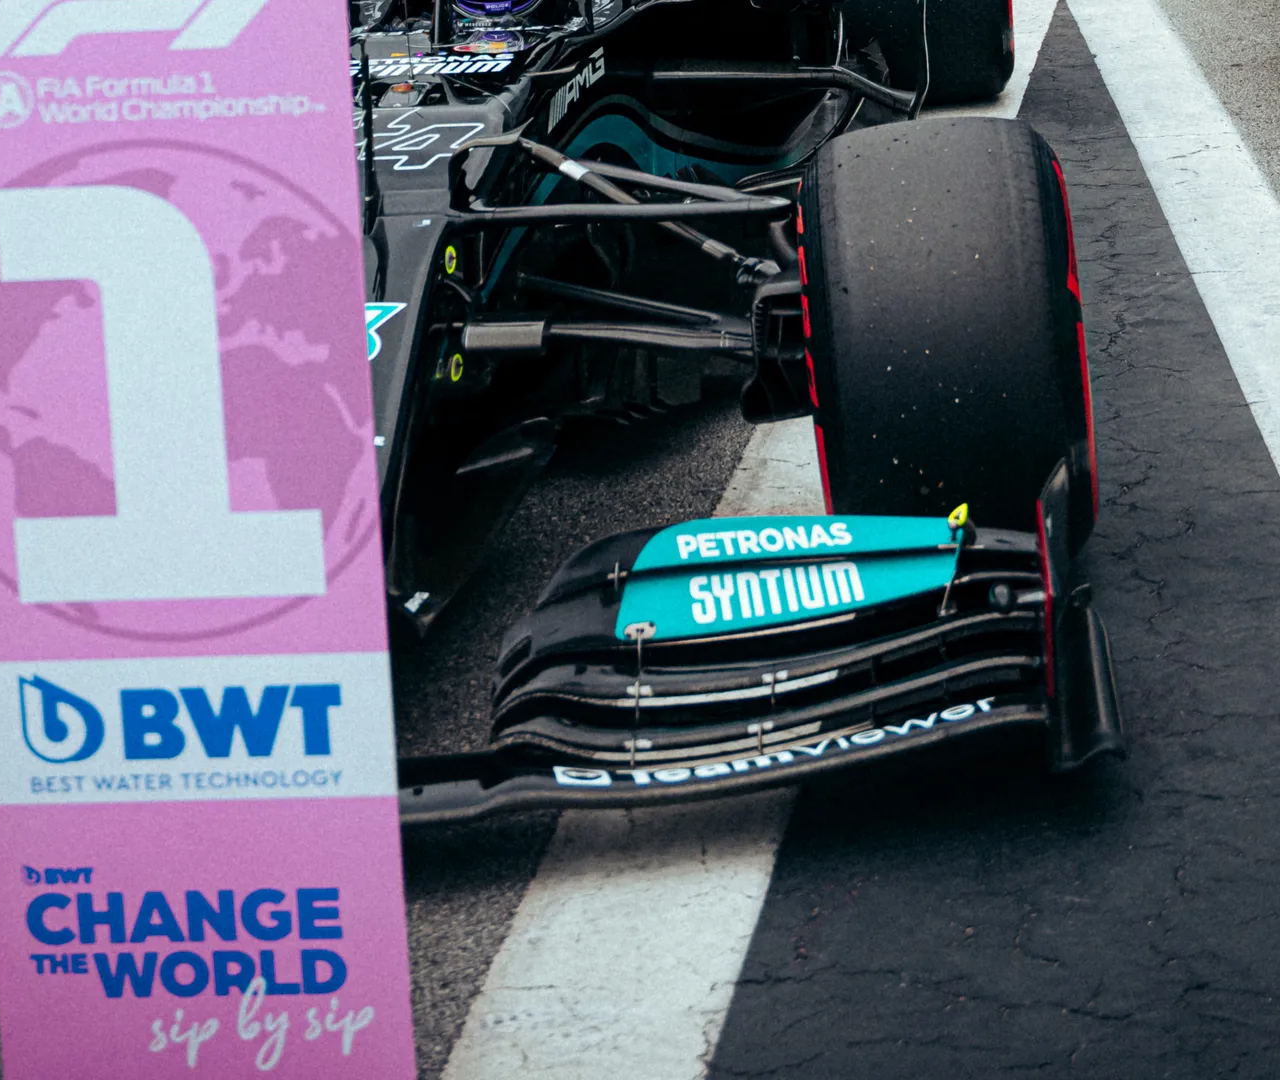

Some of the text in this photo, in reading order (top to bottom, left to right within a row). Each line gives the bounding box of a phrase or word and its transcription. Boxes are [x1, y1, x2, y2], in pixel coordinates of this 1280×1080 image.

[36, 72, 214, 97] FIA Formula 1
[564, 46, 606, 115] AMG
[39, 100, 117, 124] World
[677, 522, 853, 560] PETRONAS
[690, 561, 865, 625] SYNTIUM
[120, 684, 342, 761] BWT
[630, 696, 998, 788] TeamViewer
[30, 769, 343, 793] BEST WATER TECHNOLOGY
[44, 866, 94, 884] BWT
[25, 887, 343, 946] CHANGE
[30, 948, 348, 999] THE WORLD
[148, 976, 376, 1071] sip by sip
